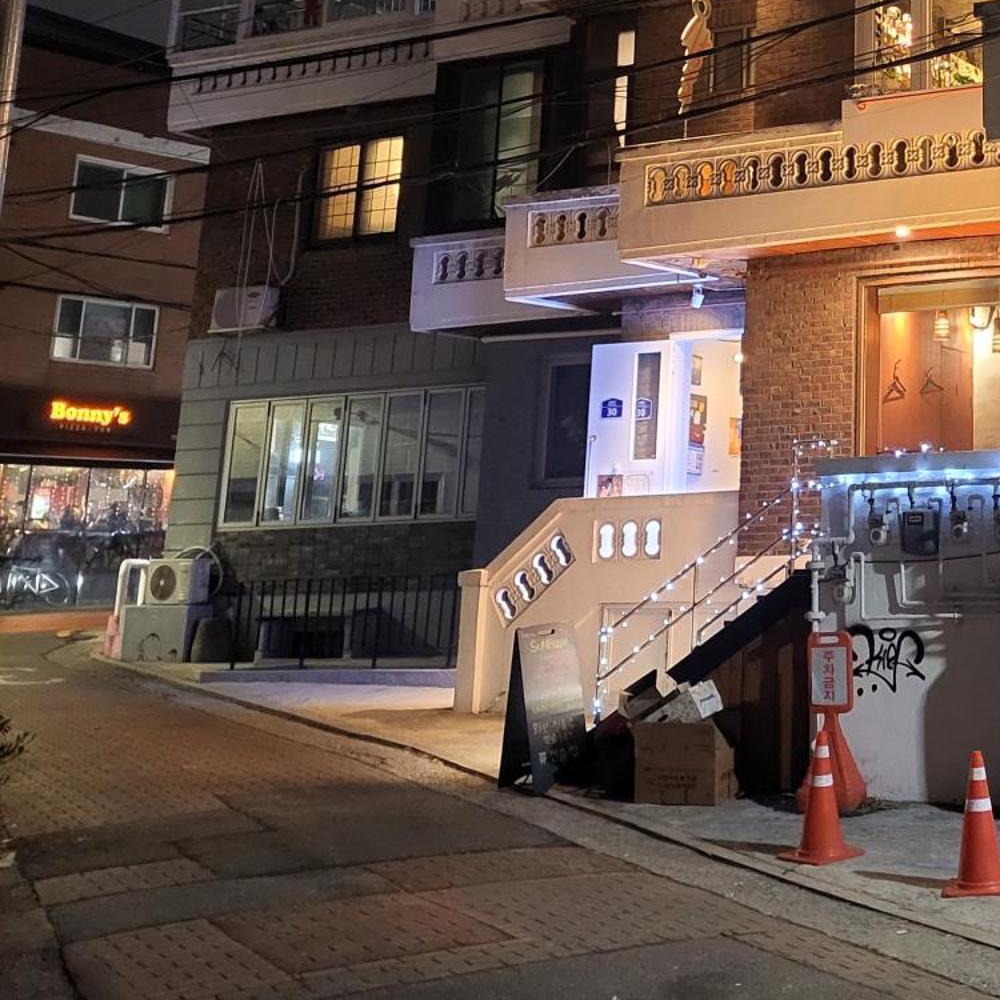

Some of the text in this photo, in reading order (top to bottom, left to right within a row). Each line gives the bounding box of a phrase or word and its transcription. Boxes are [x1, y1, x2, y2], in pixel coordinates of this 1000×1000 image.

[51, 401, 131, 425] Bonny's
[607, 407, 617, 417] 30
[822, 650, 836, 702] 주차금지
